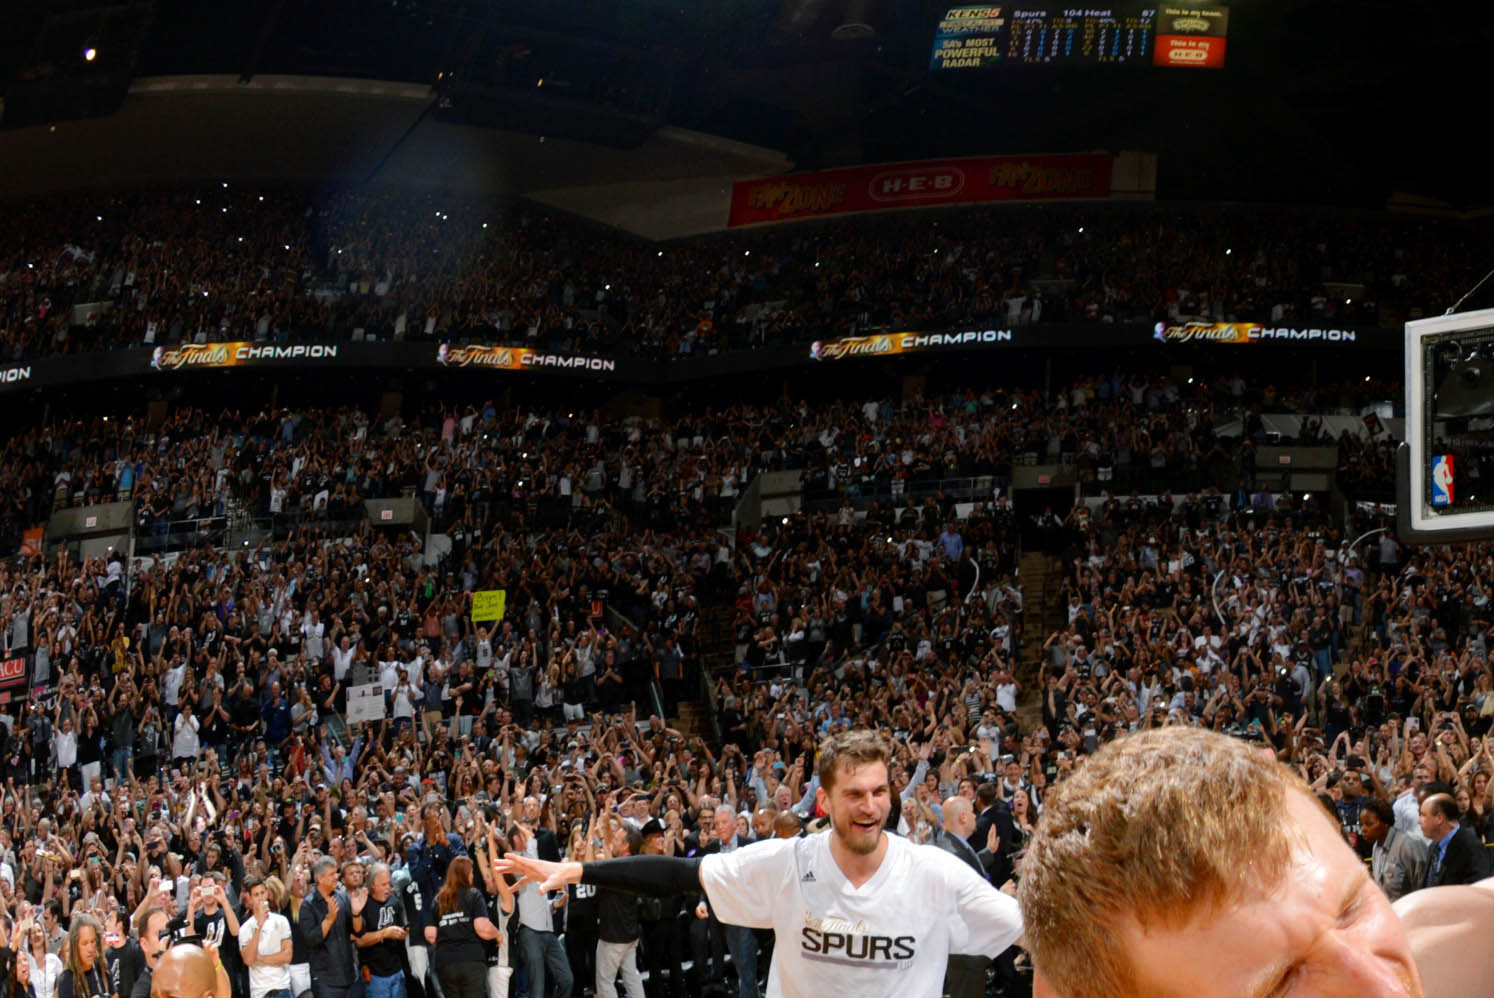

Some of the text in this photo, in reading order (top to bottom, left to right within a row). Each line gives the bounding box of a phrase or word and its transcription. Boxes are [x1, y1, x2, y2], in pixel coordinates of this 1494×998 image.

[1014, 10, 1047, 18] Spurs
[1064, 9, 1082, 17] 104
[1084, 9, 1111, 17] Heat
[966, 38, 995, 47] MOST
[934, 46, 1000, 59] POWERFUL
[943, 58, 980, 68] RADAR
[901, 330, 1012, 348] CHAMPION
[1247, 328, 1356, 341] CHAMPION
[236, 345, 337, 360] CHAMPION
[520, 353, 616, 372] CHAMPION
[801, 926, 916, 960] SPURS
